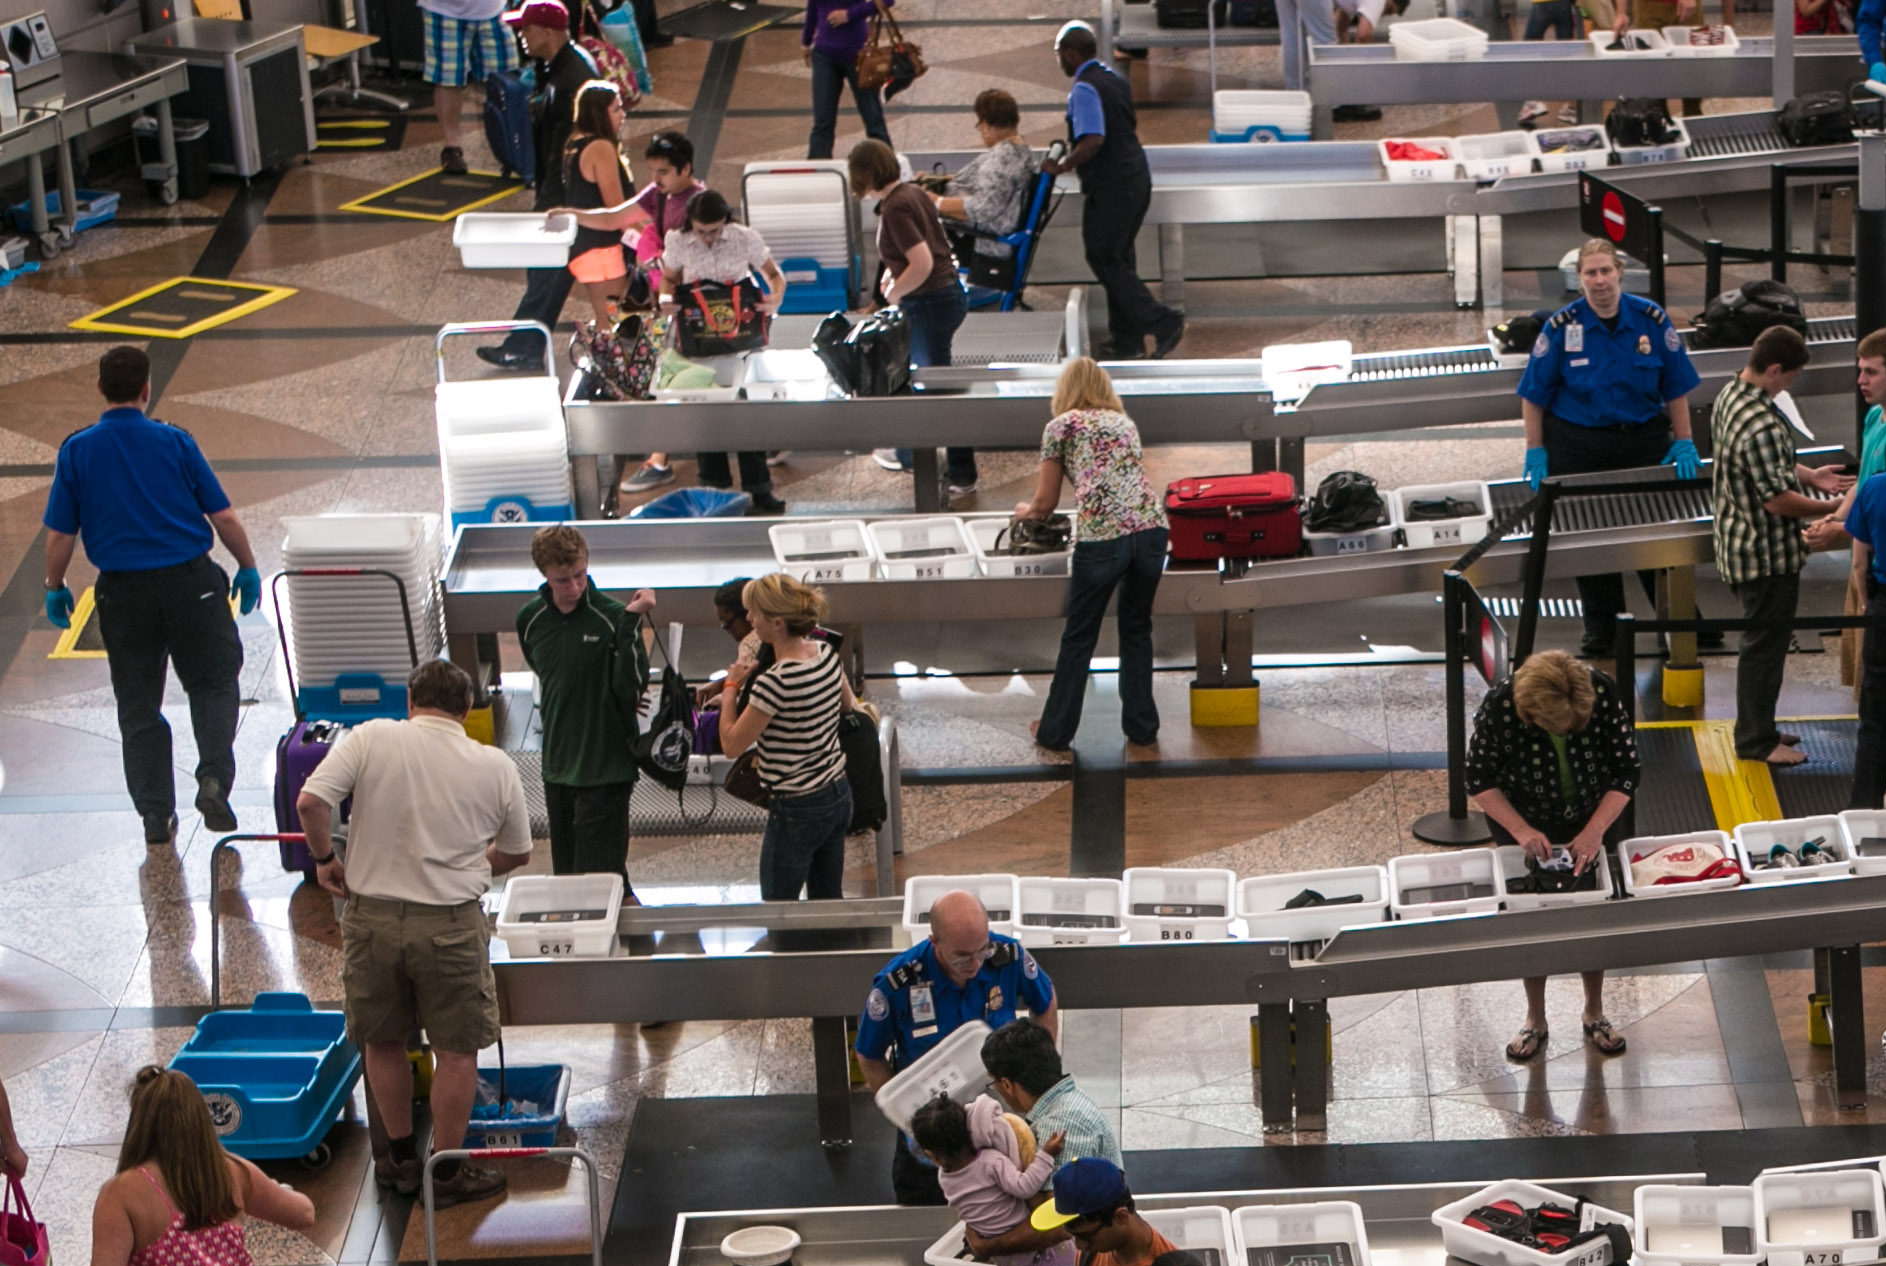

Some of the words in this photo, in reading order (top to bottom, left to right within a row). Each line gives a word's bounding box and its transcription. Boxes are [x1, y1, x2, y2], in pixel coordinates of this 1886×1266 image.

[1434, 529, 1460, 539] A14
[815, 570, 842, 579] A75
[1161, 930, 1193, 940] B80
[540, 944, 572, 955] C47
[488, 1135, 518, 1145] B61
[1805, 1254, 1841, 1264] A70
